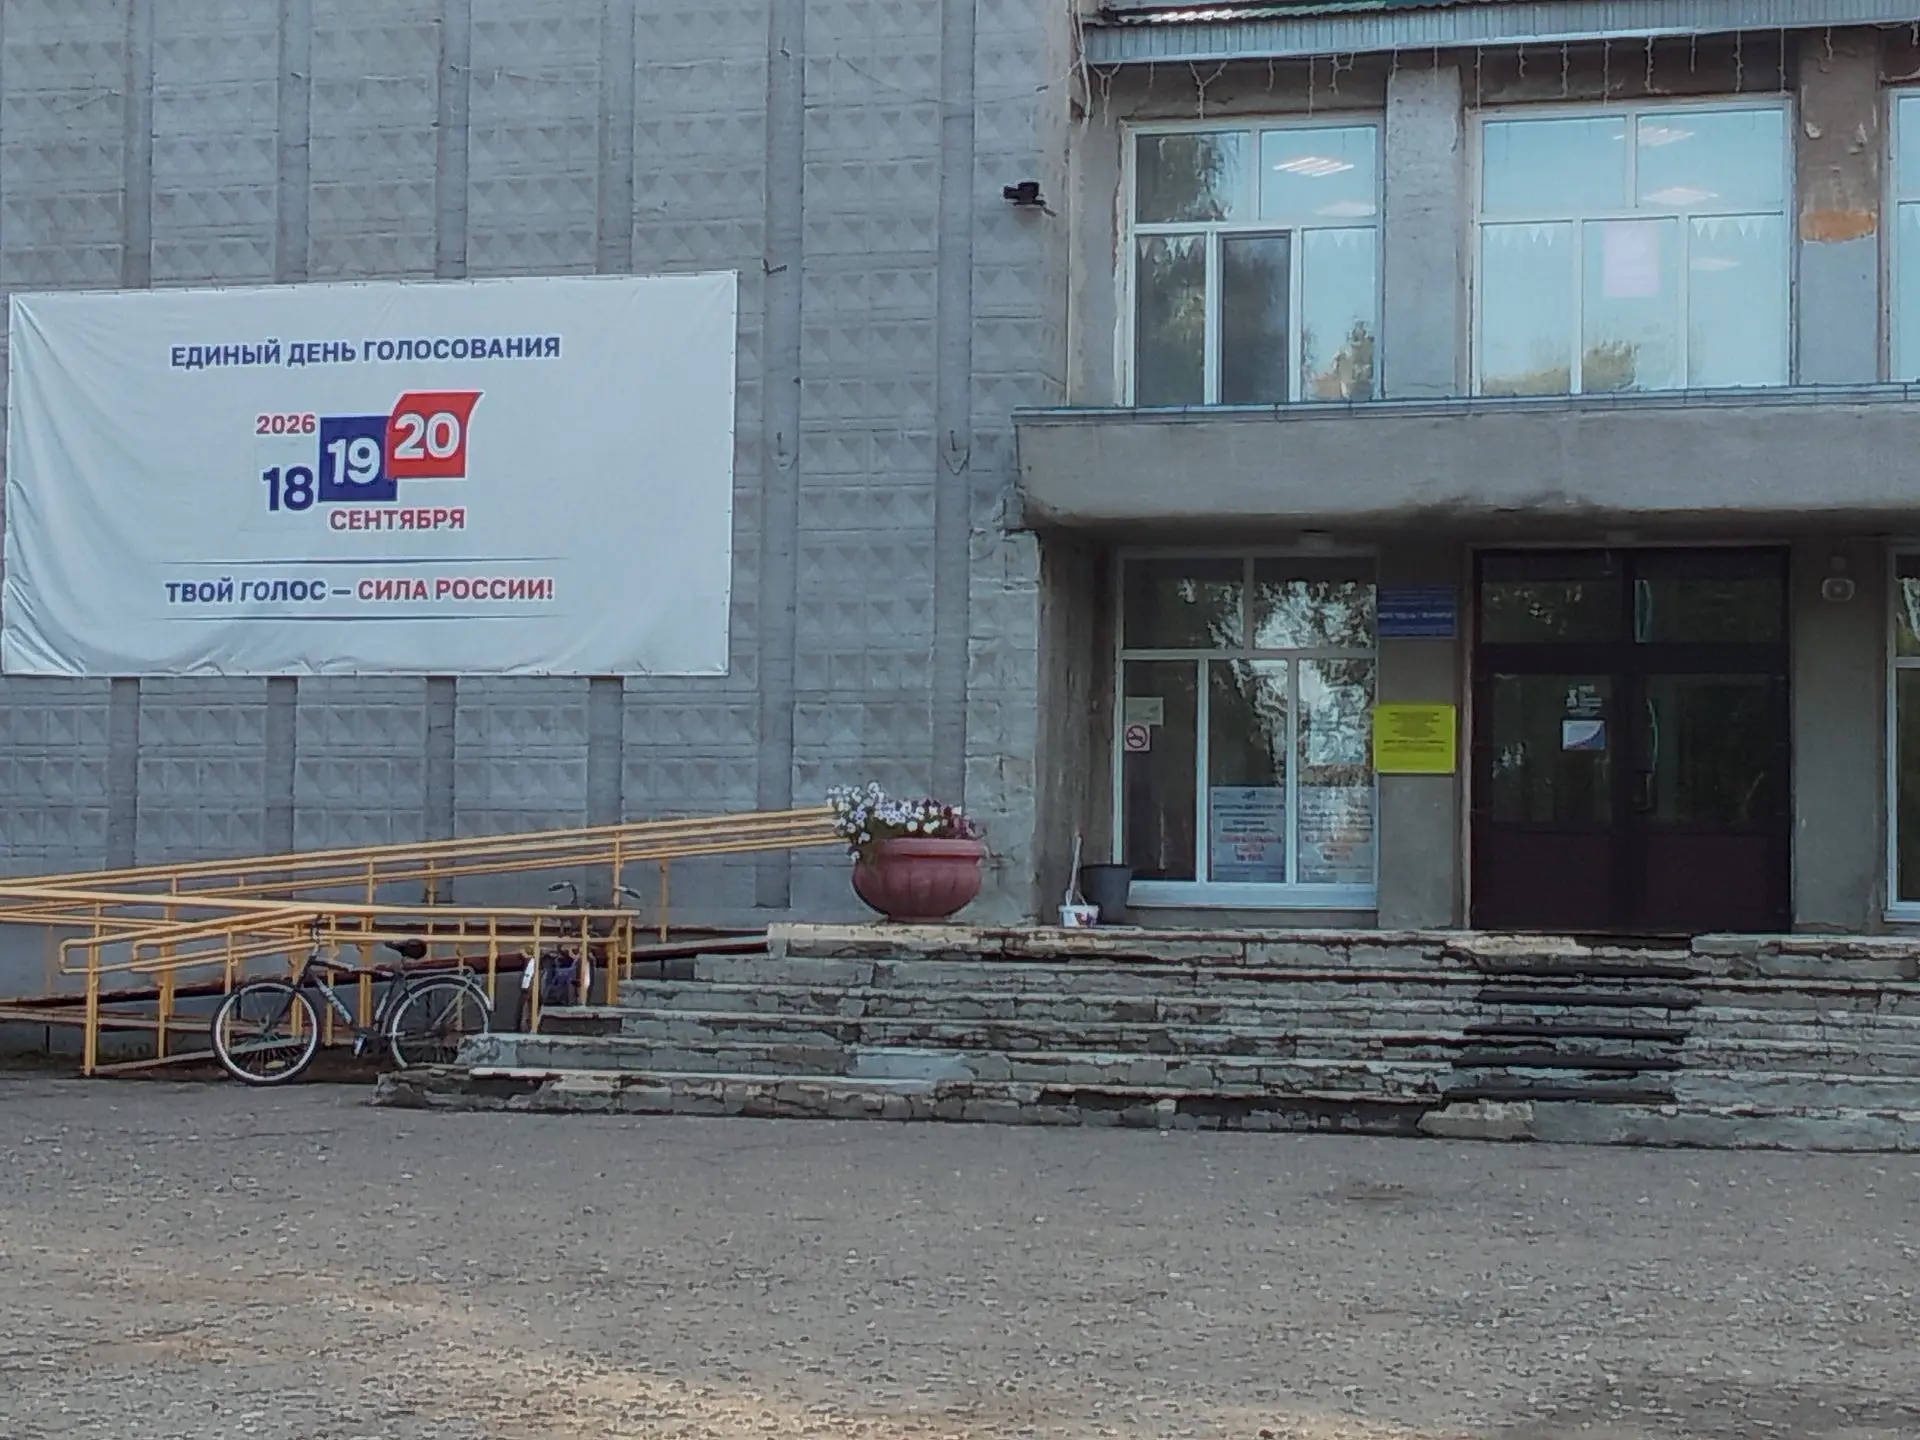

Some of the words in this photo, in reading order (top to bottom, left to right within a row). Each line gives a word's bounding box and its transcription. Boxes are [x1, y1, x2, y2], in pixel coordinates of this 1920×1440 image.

[171, 337, 281, 370] ЕДИНЫЙ
[287, 342, 357, 367] ДЕНЬ
[363, 336, 561, 362] ГОЛОСОВАНИЯ
[255, 414, 316, 435] 2026
[262, 465, 315, 512] 18
[327, 437, 381, 485] 19
[394, 412, 461, 460] 20
[330, 508, 466, 531] СЕНТЯБРЯ
[165, 576, 234, 603] ТВОЙ
[239, 580, 327, 602] ГОЛОС
[357, 579, 429, 601] СИЛА
[435, 578, 554, 600] РОССИИ!
